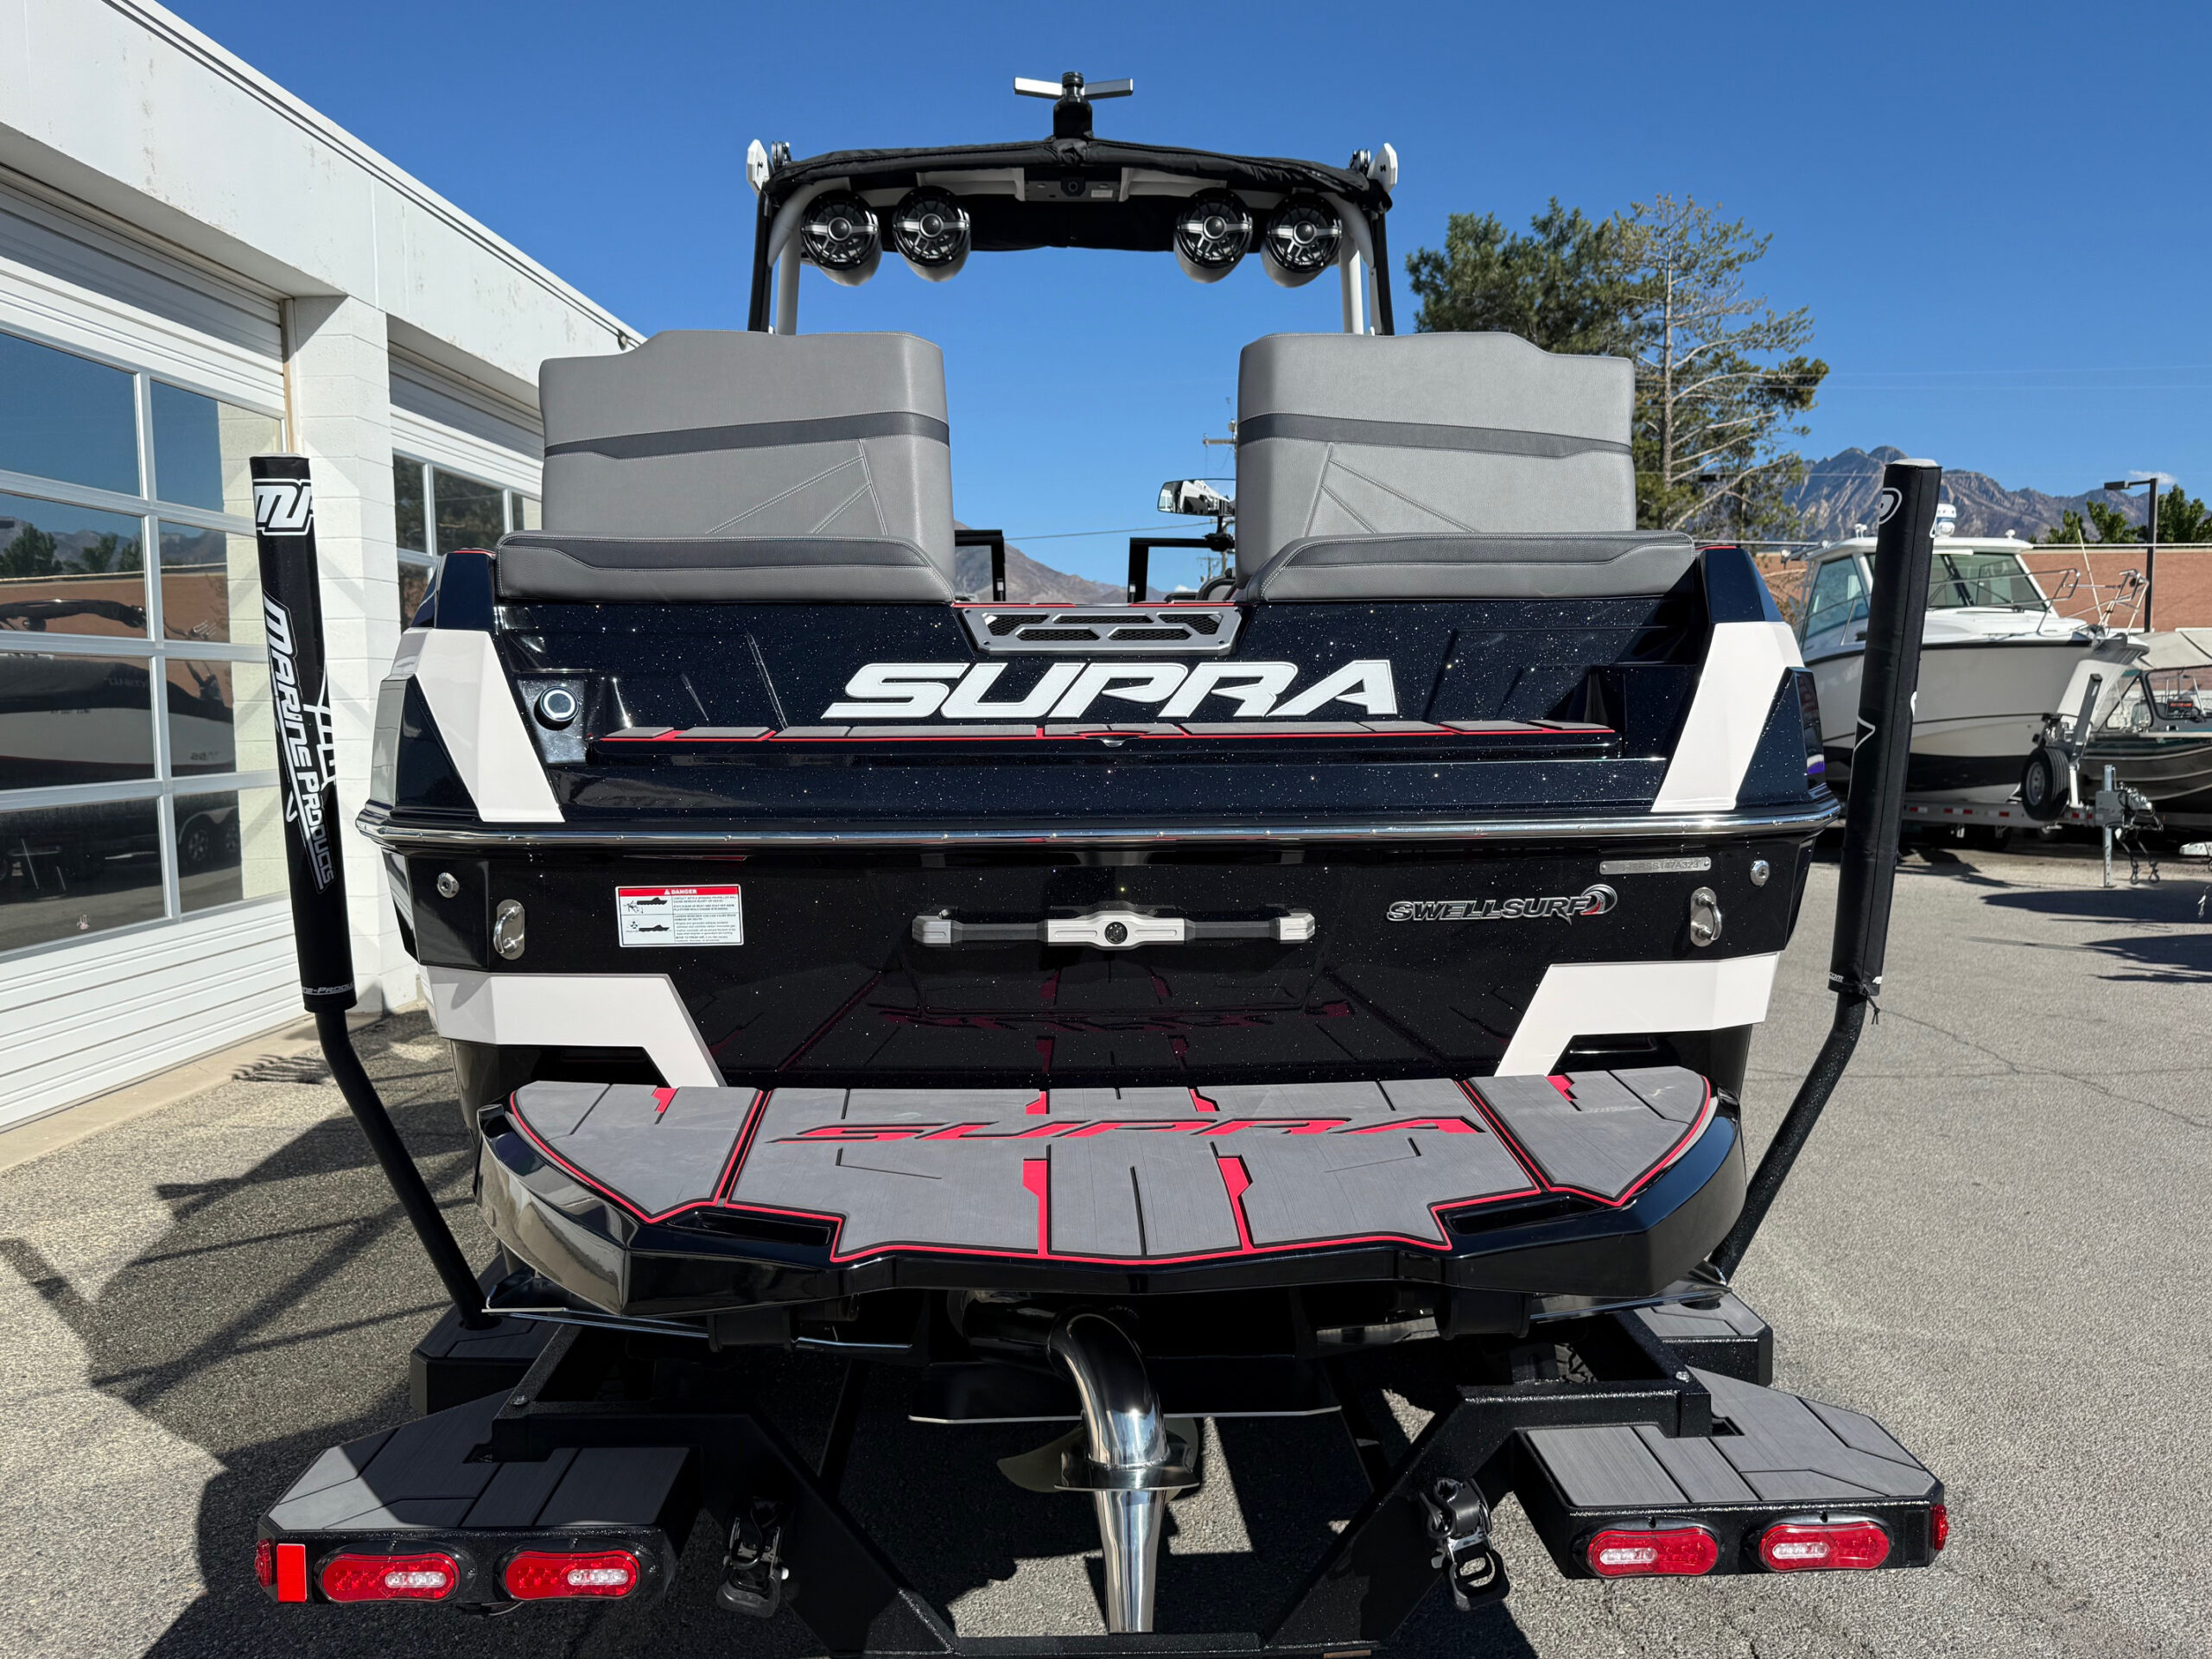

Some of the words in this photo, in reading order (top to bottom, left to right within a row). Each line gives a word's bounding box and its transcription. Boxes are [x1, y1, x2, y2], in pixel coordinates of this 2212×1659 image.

[821, 659, 1399, 719] SUPRA
[297, 771, 334, 885] PRODUCTS
[1387, 895, 1592, 925] SWELLSURF
[766, 1116, 1485, 1144] SUPRA
